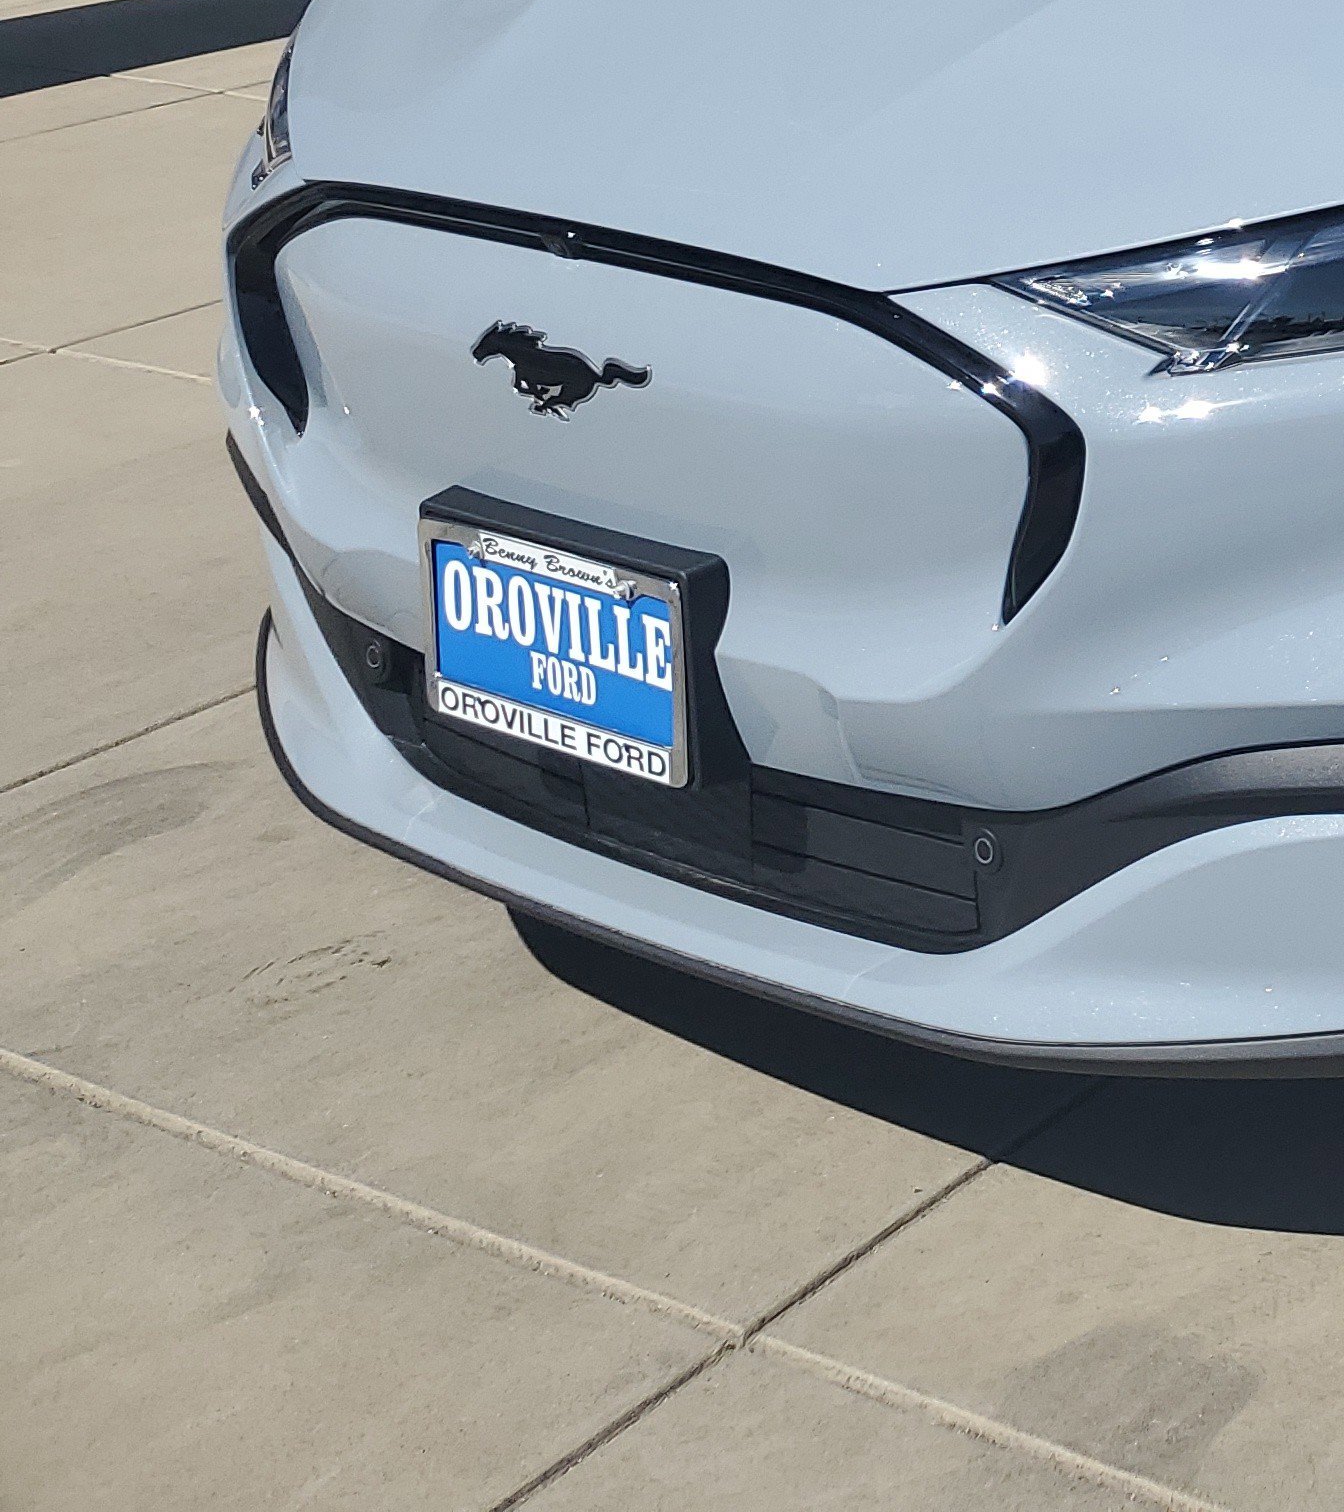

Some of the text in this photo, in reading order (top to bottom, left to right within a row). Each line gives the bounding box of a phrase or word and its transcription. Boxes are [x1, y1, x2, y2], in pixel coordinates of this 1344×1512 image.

[483, 538, 617, 589] Benny Brown's
[443, 559, 673, 692] OROVILLE
[530, 651, 597, 706] FORD
[441, 686, 667, 777] OROVILLE FORD
